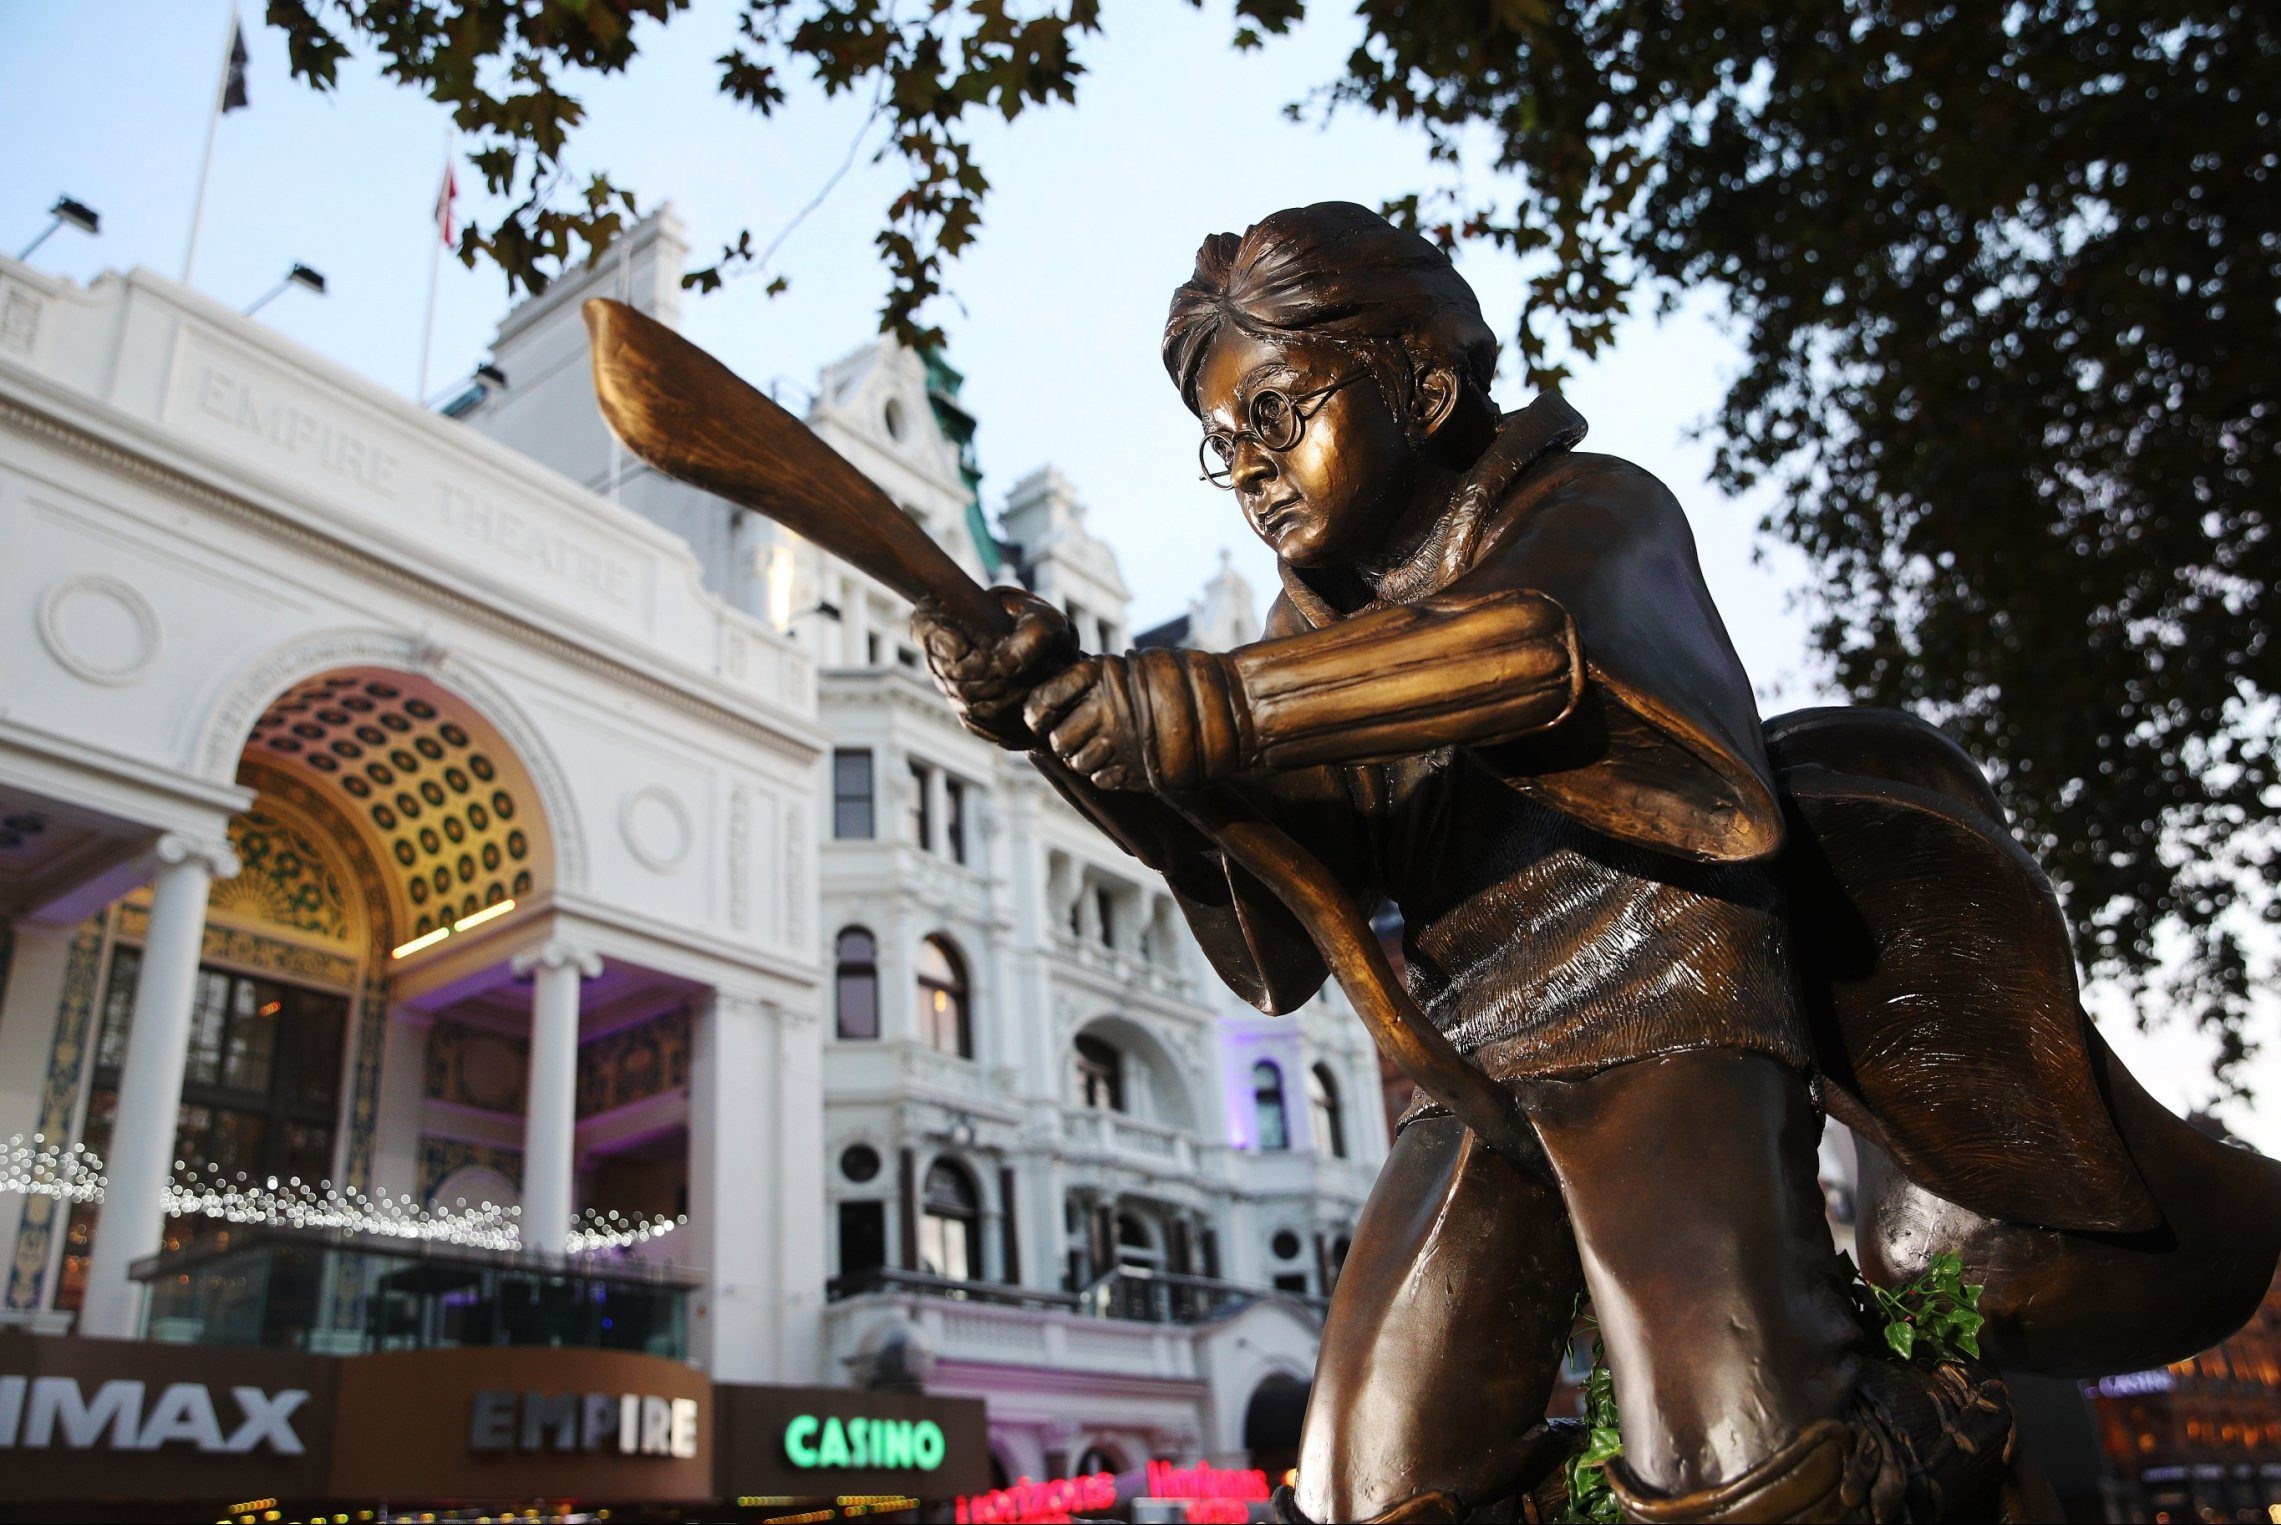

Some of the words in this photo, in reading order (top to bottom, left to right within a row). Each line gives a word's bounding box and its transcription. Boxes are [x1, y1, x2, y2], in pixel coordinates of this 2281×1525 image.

[198, 364, 402, 498] EMPIRE
[431, 477, 633, 606] THEATRE
[0, 1375, 310, 1454] IMAX
[470, 1390, 699, 1459] EMPIRE
[784, 1414, 946, 1471] CASINO
